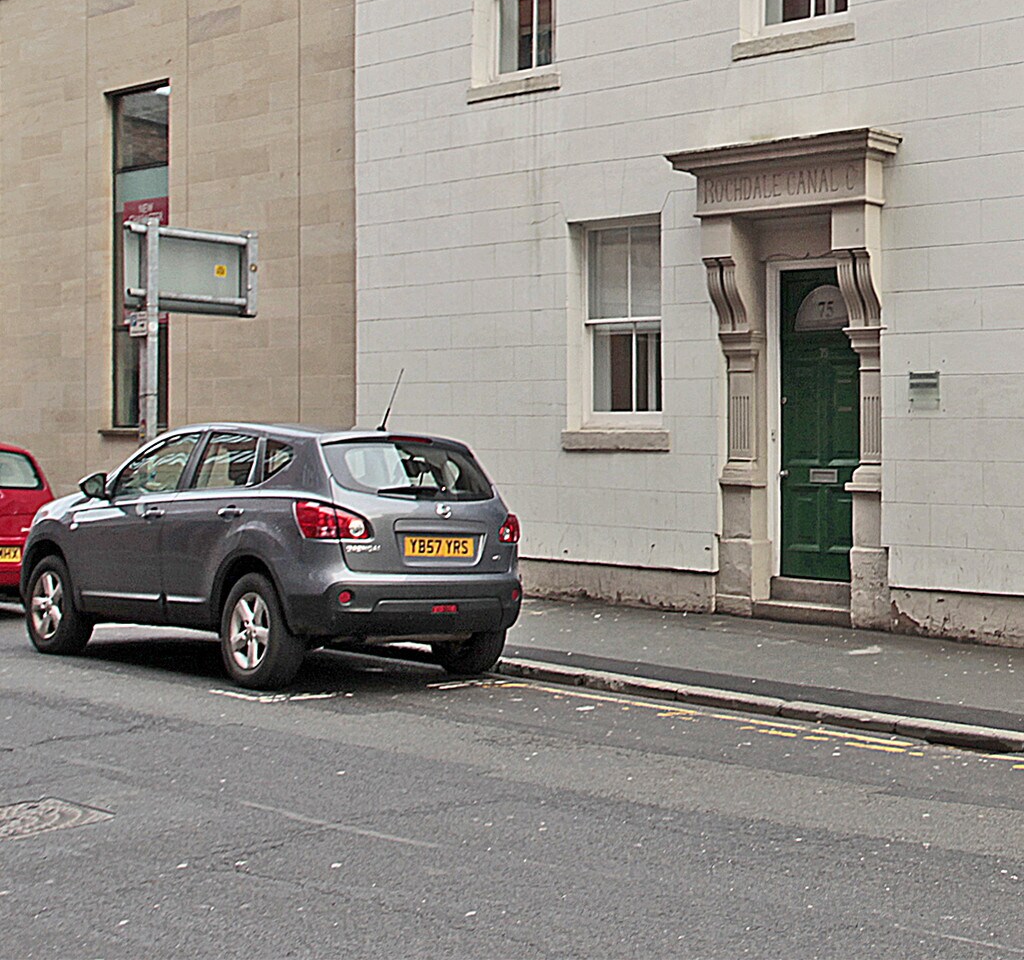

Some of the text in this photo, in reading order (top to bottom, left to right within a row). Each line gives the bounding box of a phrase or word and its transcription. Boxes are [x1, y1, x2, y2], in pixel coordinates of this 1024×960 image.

[703, 174, 781, 204] ROCHDALE
[786, 167, 838, 196] CANAL
[818, 301, 834, 318] 75
[409, 540, 469, 554] YB57 YRS
